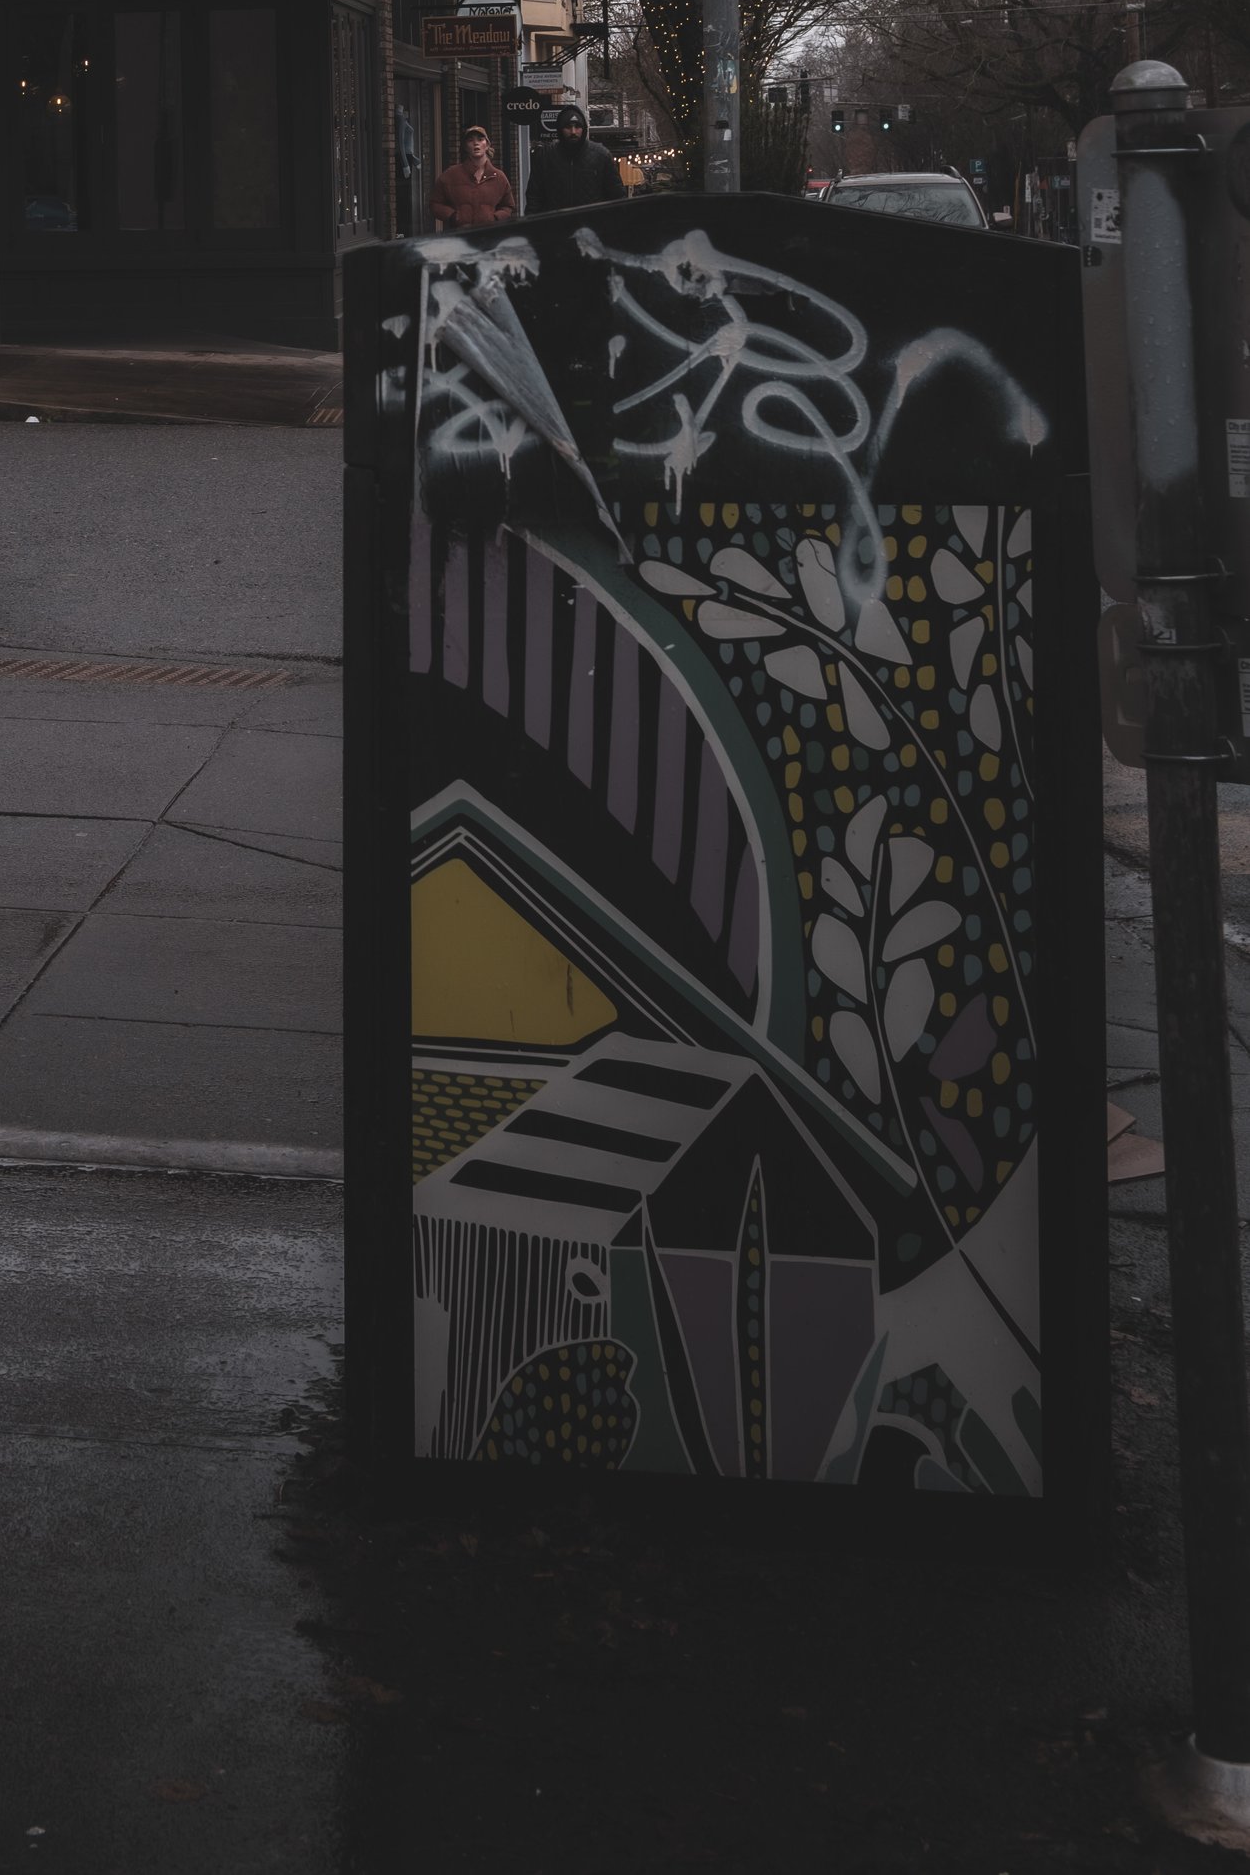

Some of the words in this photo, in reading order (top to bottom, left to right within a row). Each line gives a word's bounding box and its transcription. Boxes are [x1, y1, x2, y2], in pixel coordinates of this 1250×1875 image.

[427, 22, 453, 45] The
[454, 23, 510, 45] Meadow
[506, 98, 540, 110] credo
